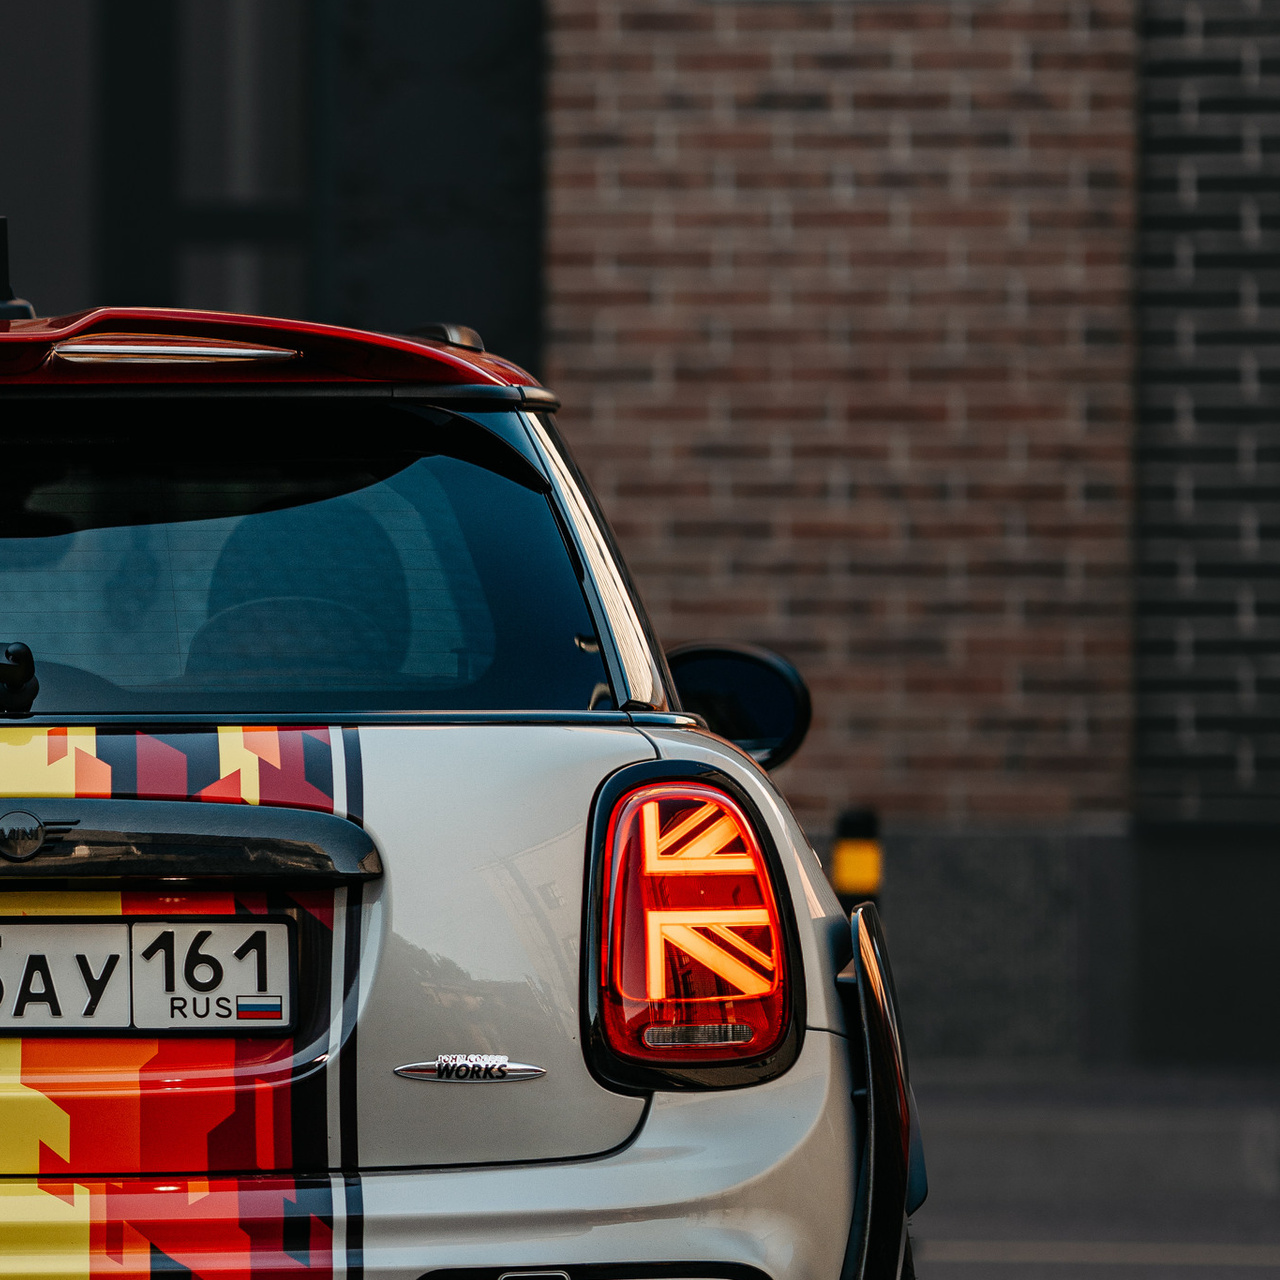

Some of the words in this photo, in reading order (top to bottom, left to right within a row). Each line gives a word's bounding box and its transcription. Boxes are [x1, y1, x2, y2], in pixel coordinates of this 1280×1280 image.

[0, 827, 39, 841] MINI
[141, 929, 269, 993] 161
[171, 996, 232, 1019] RUS
[436, 1063, 508, 1079] WORKS
